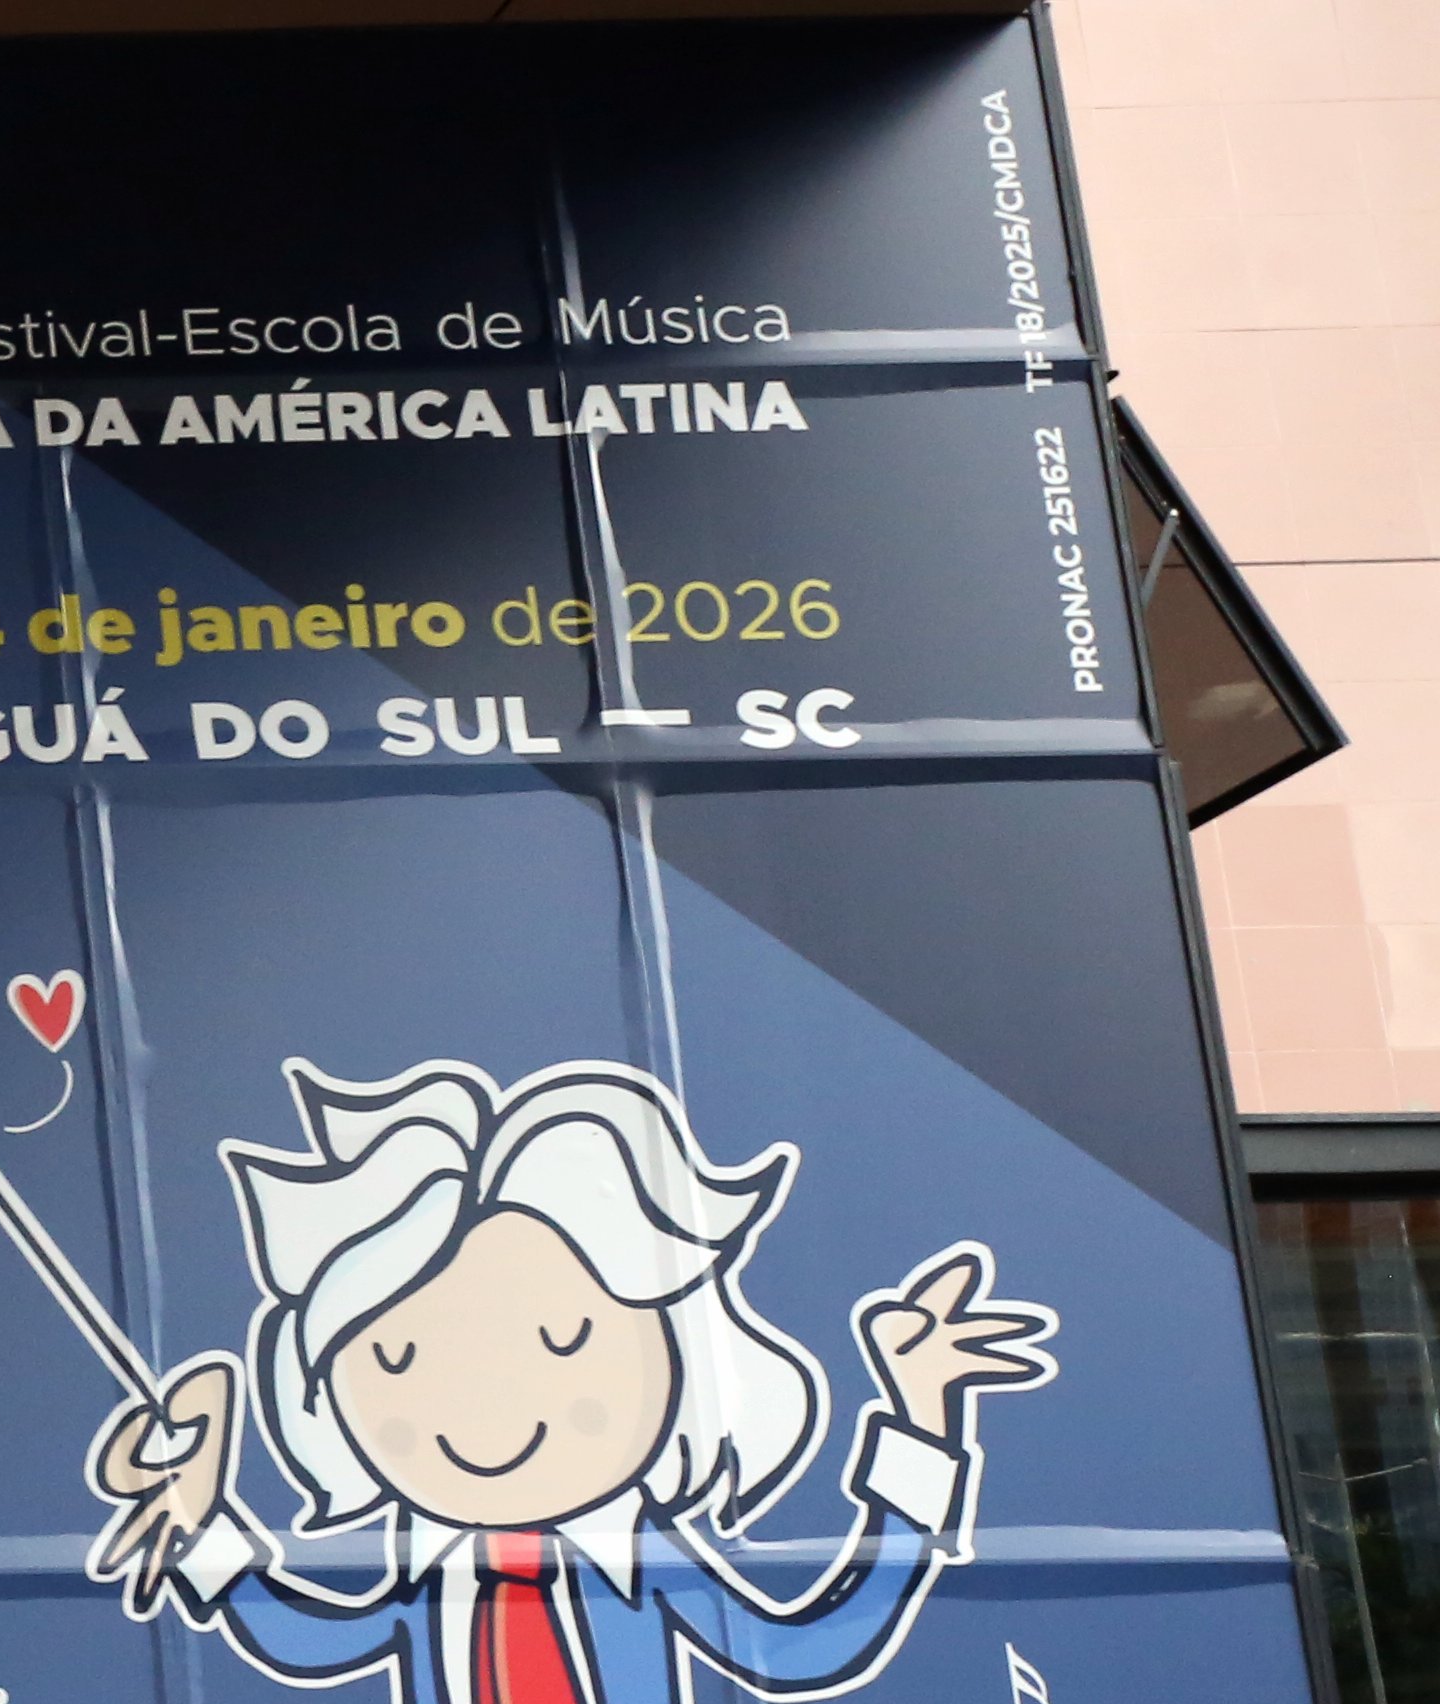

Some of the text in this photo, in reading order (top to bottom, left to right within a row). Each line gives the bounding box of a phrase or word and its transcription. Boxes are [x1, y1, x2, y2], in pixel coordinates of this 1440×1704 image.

[980, 89, 1054, 395] TF 18/2025/CMDCA
[437, 300, 523, 351] de
[561, 294, 791, 347] Música
[34, 396, 141, 448] DA
[160, 379, 511, 444] AMÉRICA
[531, 382, 808, 437] LATINA
[1026, 425, 1104, 693] PRONAC 251622
[26, 593, 135, 654] de
[154, 587, 466, 667] janeiro
[492, 587, 595, 646] de
[627, 579, 841, 644] 2026
[192, 701, 328, 763] DO
[380, 697, 559, 755] SUL
[737, 688, 862, 750] SC
